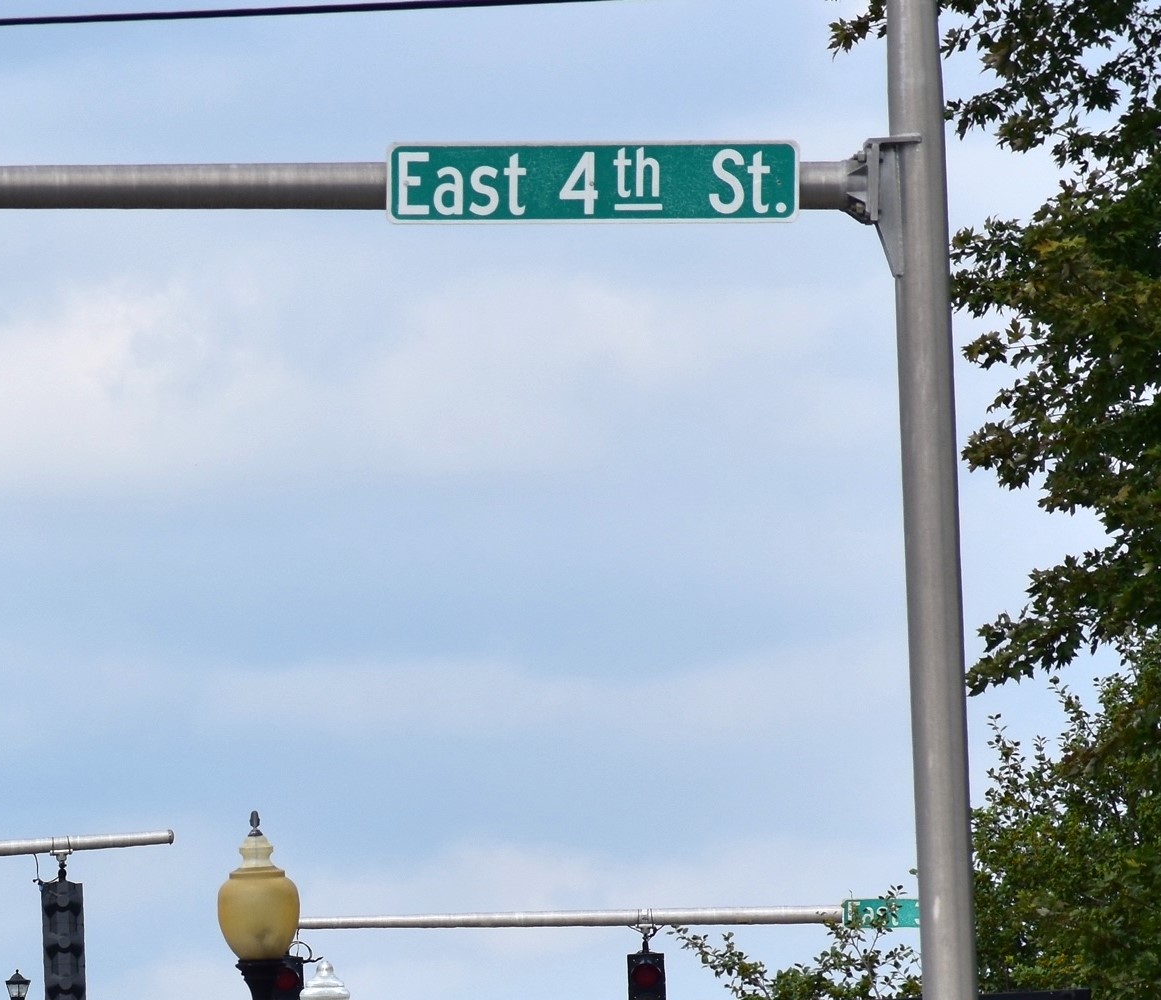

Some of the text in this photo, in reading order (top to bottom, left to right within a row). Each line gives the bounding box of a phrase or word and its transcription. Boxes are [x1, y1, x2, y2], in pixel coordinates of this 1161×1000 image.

[398, 147, 788, 216] East 4th St.
